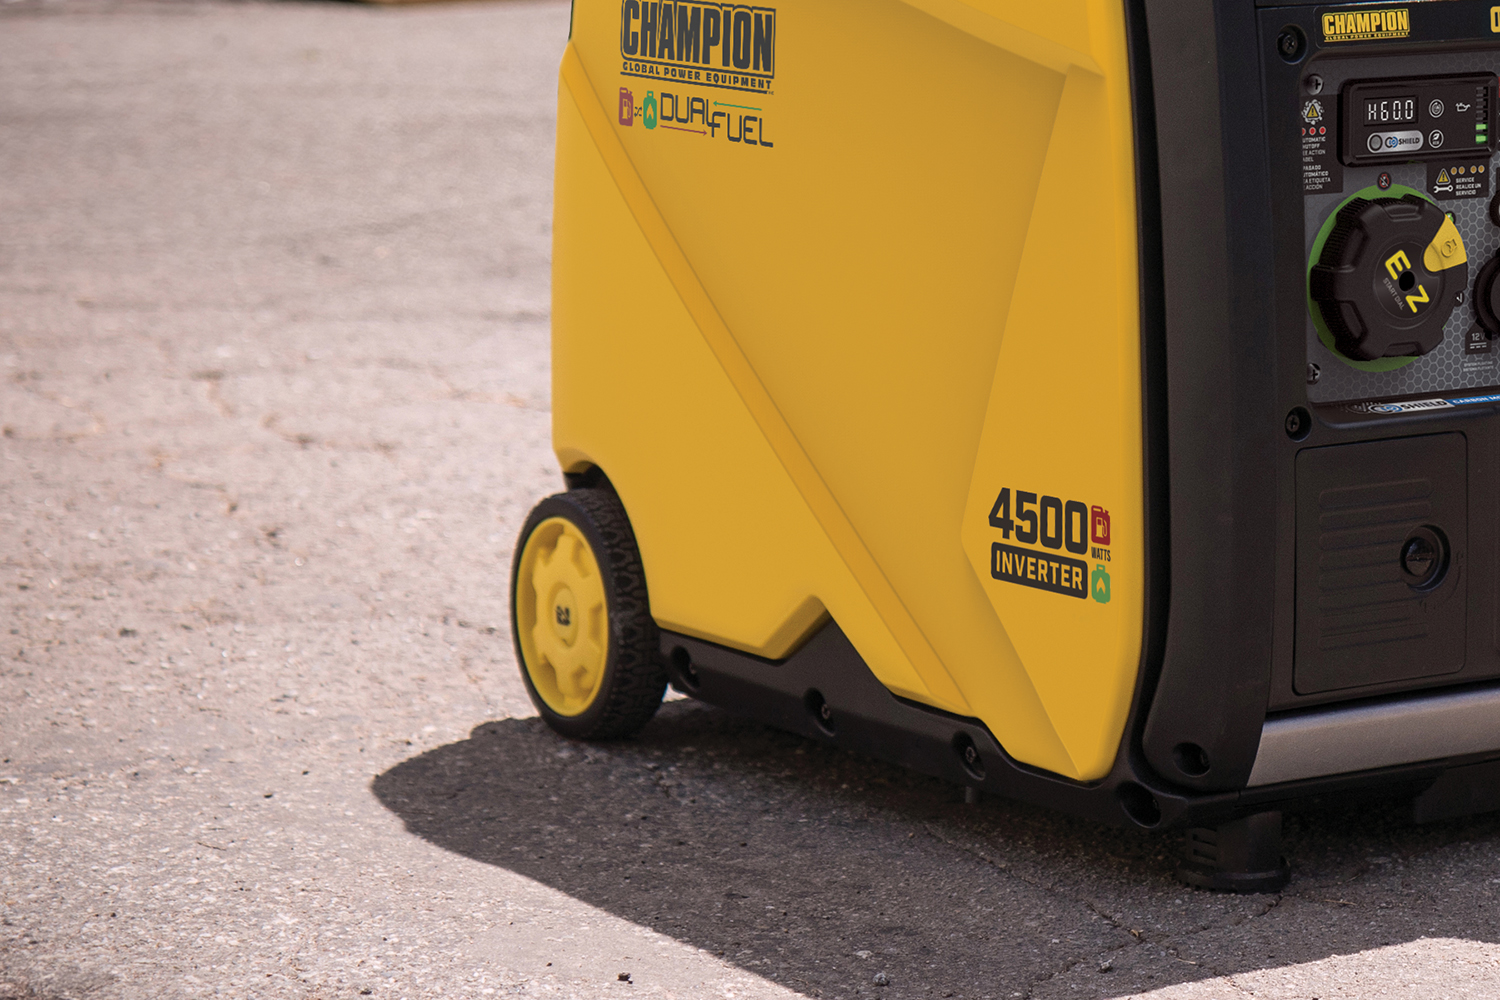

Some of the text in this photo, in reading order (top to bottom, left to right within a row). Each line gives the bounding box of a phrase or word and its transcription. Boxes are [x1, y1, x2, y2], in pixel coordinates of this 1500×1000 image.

[1323, 10, 1408, 35] CHAMPION
[623, 61, 772, 90] GLOBAL POWER EQUIPMENT
[1398, 137, 1420, 146] SHIELD
[1382, 277, 1405, 310] START DIAL
[1401, 399, 1448, 411] SHIELD
[1452, 397, 1489, 405] CARBON
[988, 486, 1088, 555] 4500
[1091, 546, 1112, 562] WATTS
[996, 549, 1083, 591] INVERTER
